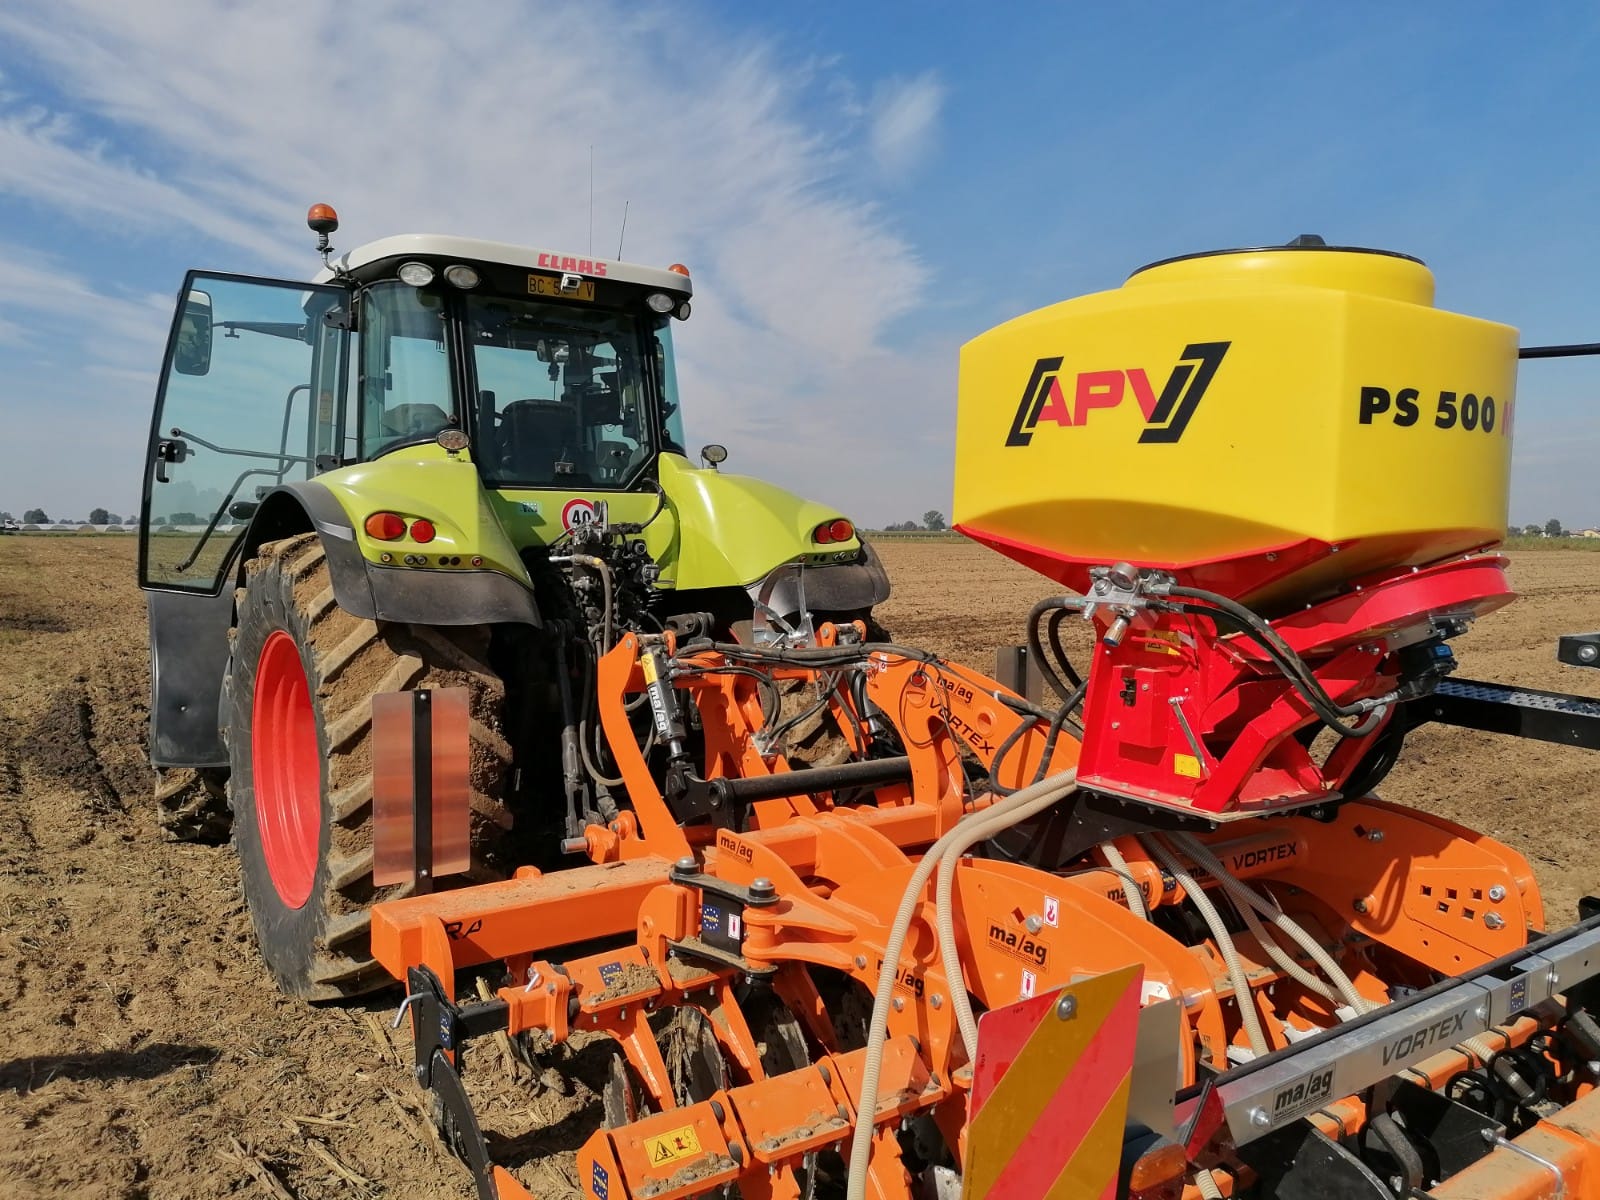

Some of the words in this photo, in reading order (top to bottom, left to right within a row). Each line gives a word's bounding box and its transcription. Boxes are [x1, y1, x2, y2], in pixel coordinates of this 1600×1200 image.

[538, 253, 607, 276] CLAAS
[529, 278, 545, 294] BC
[1359, 386, 1420, 427] PS
[1434, 391, 1495, 433] 500
[572, 509, 591, 525] 40
[650, 686, 668, 732] ma/ag
[930, 697, 995, 756] VORTEX
[720, 836, 753, 863] ma/ag
[1233, 842, 1297, 870] VORTEX
[989, 925, 1047, 965] ma/ag
[1382, 1009, 1468, 1066] VORTEX
[1275, 1070, 1333, 1111] ma/ag
